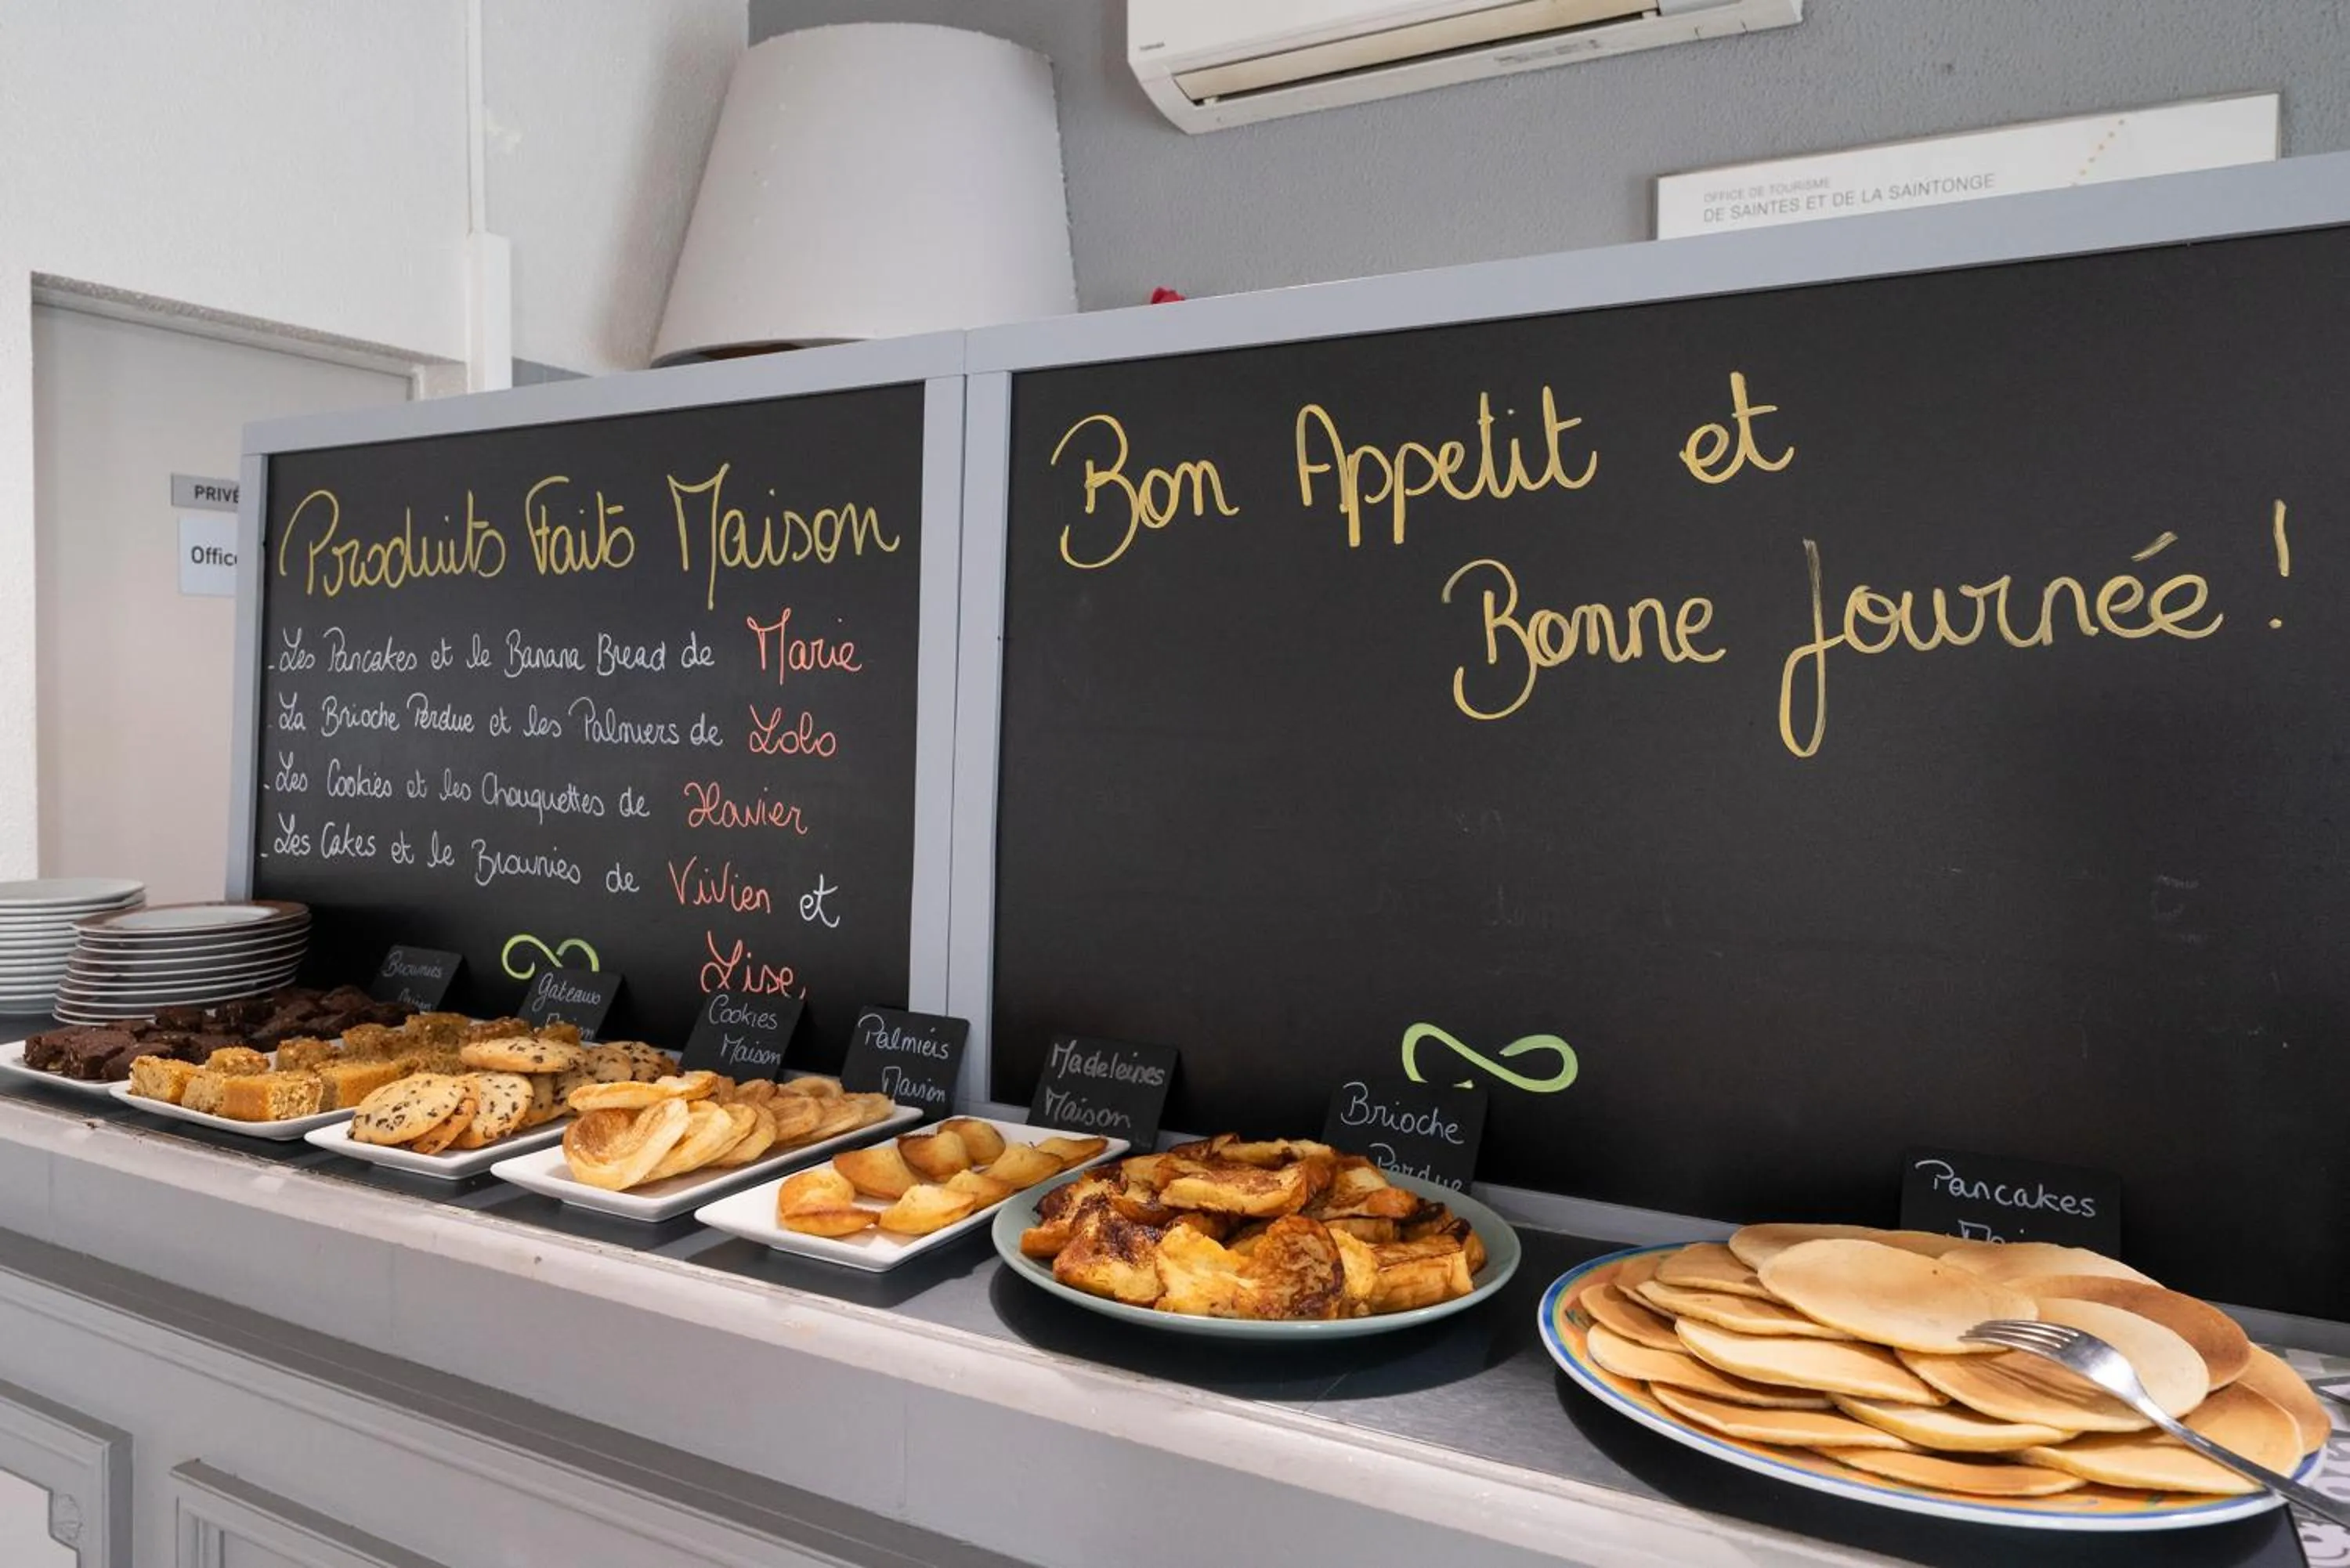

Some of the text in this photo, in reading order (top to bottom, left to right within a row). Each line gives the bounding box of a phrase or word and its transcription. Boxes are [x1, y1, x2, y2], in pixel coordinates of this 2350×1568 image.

[1704, 178, 1831, 202] OFFICE DE TOURISME
[1704, 173, 1994, 222] DE SAINTES ET DE LA SAINTONGE
[1052, 414, 1238, 569] Bon
[1680, 372, 1795, 483] et
[191, 546, 237, 566] Offic
[279, 463, 901, 609] Produits Faits Maison
[1442, 559, 1726, 720] Bonne
[2269, 499, 2290, 629] !
[323, 627, 418, 673] Pancakes
[430, 638, 453, 670] et
[467, 634, 491, 669] le
[504, 629, 586, 677] Banana
[596, 632, 666, 676] Bread
[681, 630, 714, 669] de
[747, 608, 862, 685] Marie
[321, 695, 400, 737] Brioche
[407, 692, 475, 732] Perdue
[490, 706, 512, 737] et
[523, 704, 562, 738] les
[569, 696, 679, 746] Palmiers
[690, 713, 723, 746] de
[750, 704, 837, 757] Lolo
[327, 758, 392, 799] Cookies
[407, 770, 427, 798] et
[439, 768, 471, 801] les
[482, 771, 605, 825] Chouquettes
[619, 786, 650, 818] de
[321, 822, 376, 858] Cakes
[391, 830, 414, 864] et
[427, 830, 455, 868] le
[606, 862, 640, 894] de
[800, 874, 841, 928] et
[532, 972, 601, 1012] Gateaux
[709, 994, 778, 1030] Cookies
[720, 1033, 782, 1066] Maison
[858, 1013, 949, 1060] Palmiers
[882, 1067, 945, 1103] Maison
[1050, 1039, 1166, 1086] Madeleines
[1046, 1086, 1131, 1129] Maison
[1340, 1082, 1465, 1144] Brioche
[1915, 1159, 2096, 1217] Pancakes
